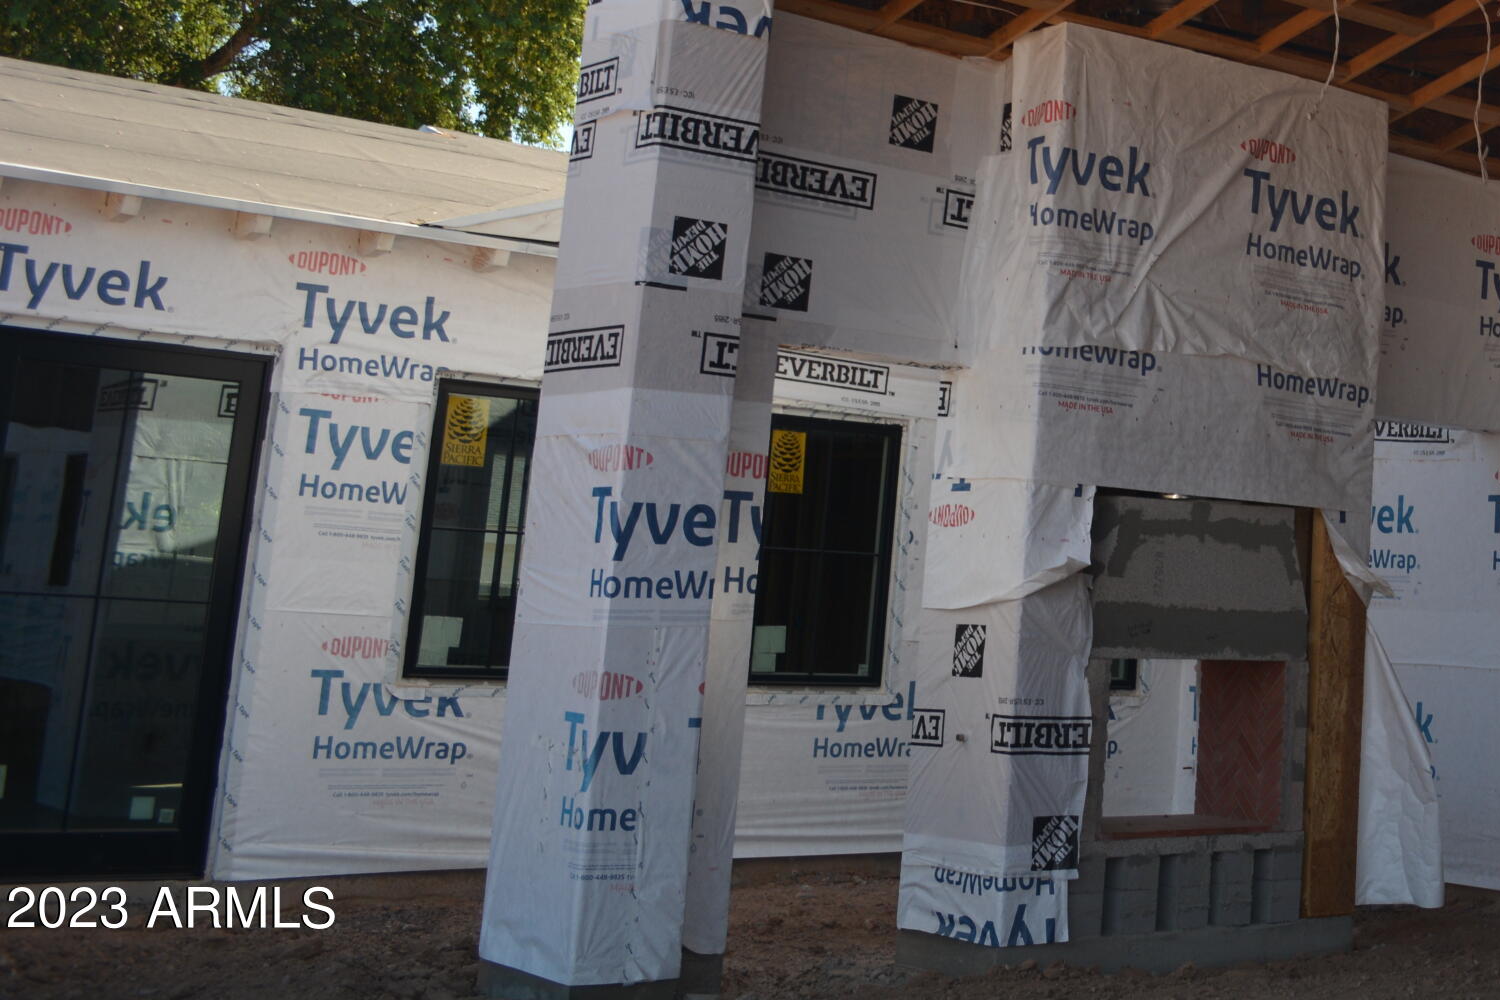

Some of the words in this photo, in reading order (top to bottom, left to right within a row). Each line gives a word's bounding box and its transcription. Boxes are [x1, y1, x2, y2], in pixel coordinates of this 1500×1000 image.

[579, 65, 615, 96] BILT
[640, 111, 760, 154] VERBILT
[1026, 100, 1071, 127] DUPONT
[1027, 134, 1150, 198] Tyvek
[1248, 138, 1291, 164] DUPONT
[755, 158, 870, 203] EVERBI
[1030, 203, 1154, 246] HomeWrap
[1243, 168, 1360, 239] Tyvek
[297, 251, 359, 275] DUPONT
[670, 222, 727, 275] HOME
[1246, 232, 1361, 281] HomeWrap
[296, 282, 451, 344] Tyvek
[300, 348, 449, 382] HomeWra
[775, 355, 884, 389] EVERBILT
[1256, 364, 1370, 408] HomeWrap
[299, 408, 414, 471] Tyve
[299, 474, 407, 505] HomeW
[592, 486, 716, 561] Tyve
[312, 736, 467, 765] HomeWrap
[564, 711, 647, 792] Tyv
[994, 722, 1091, 750] ERBILT
[560, 796, 636, 832] Home
